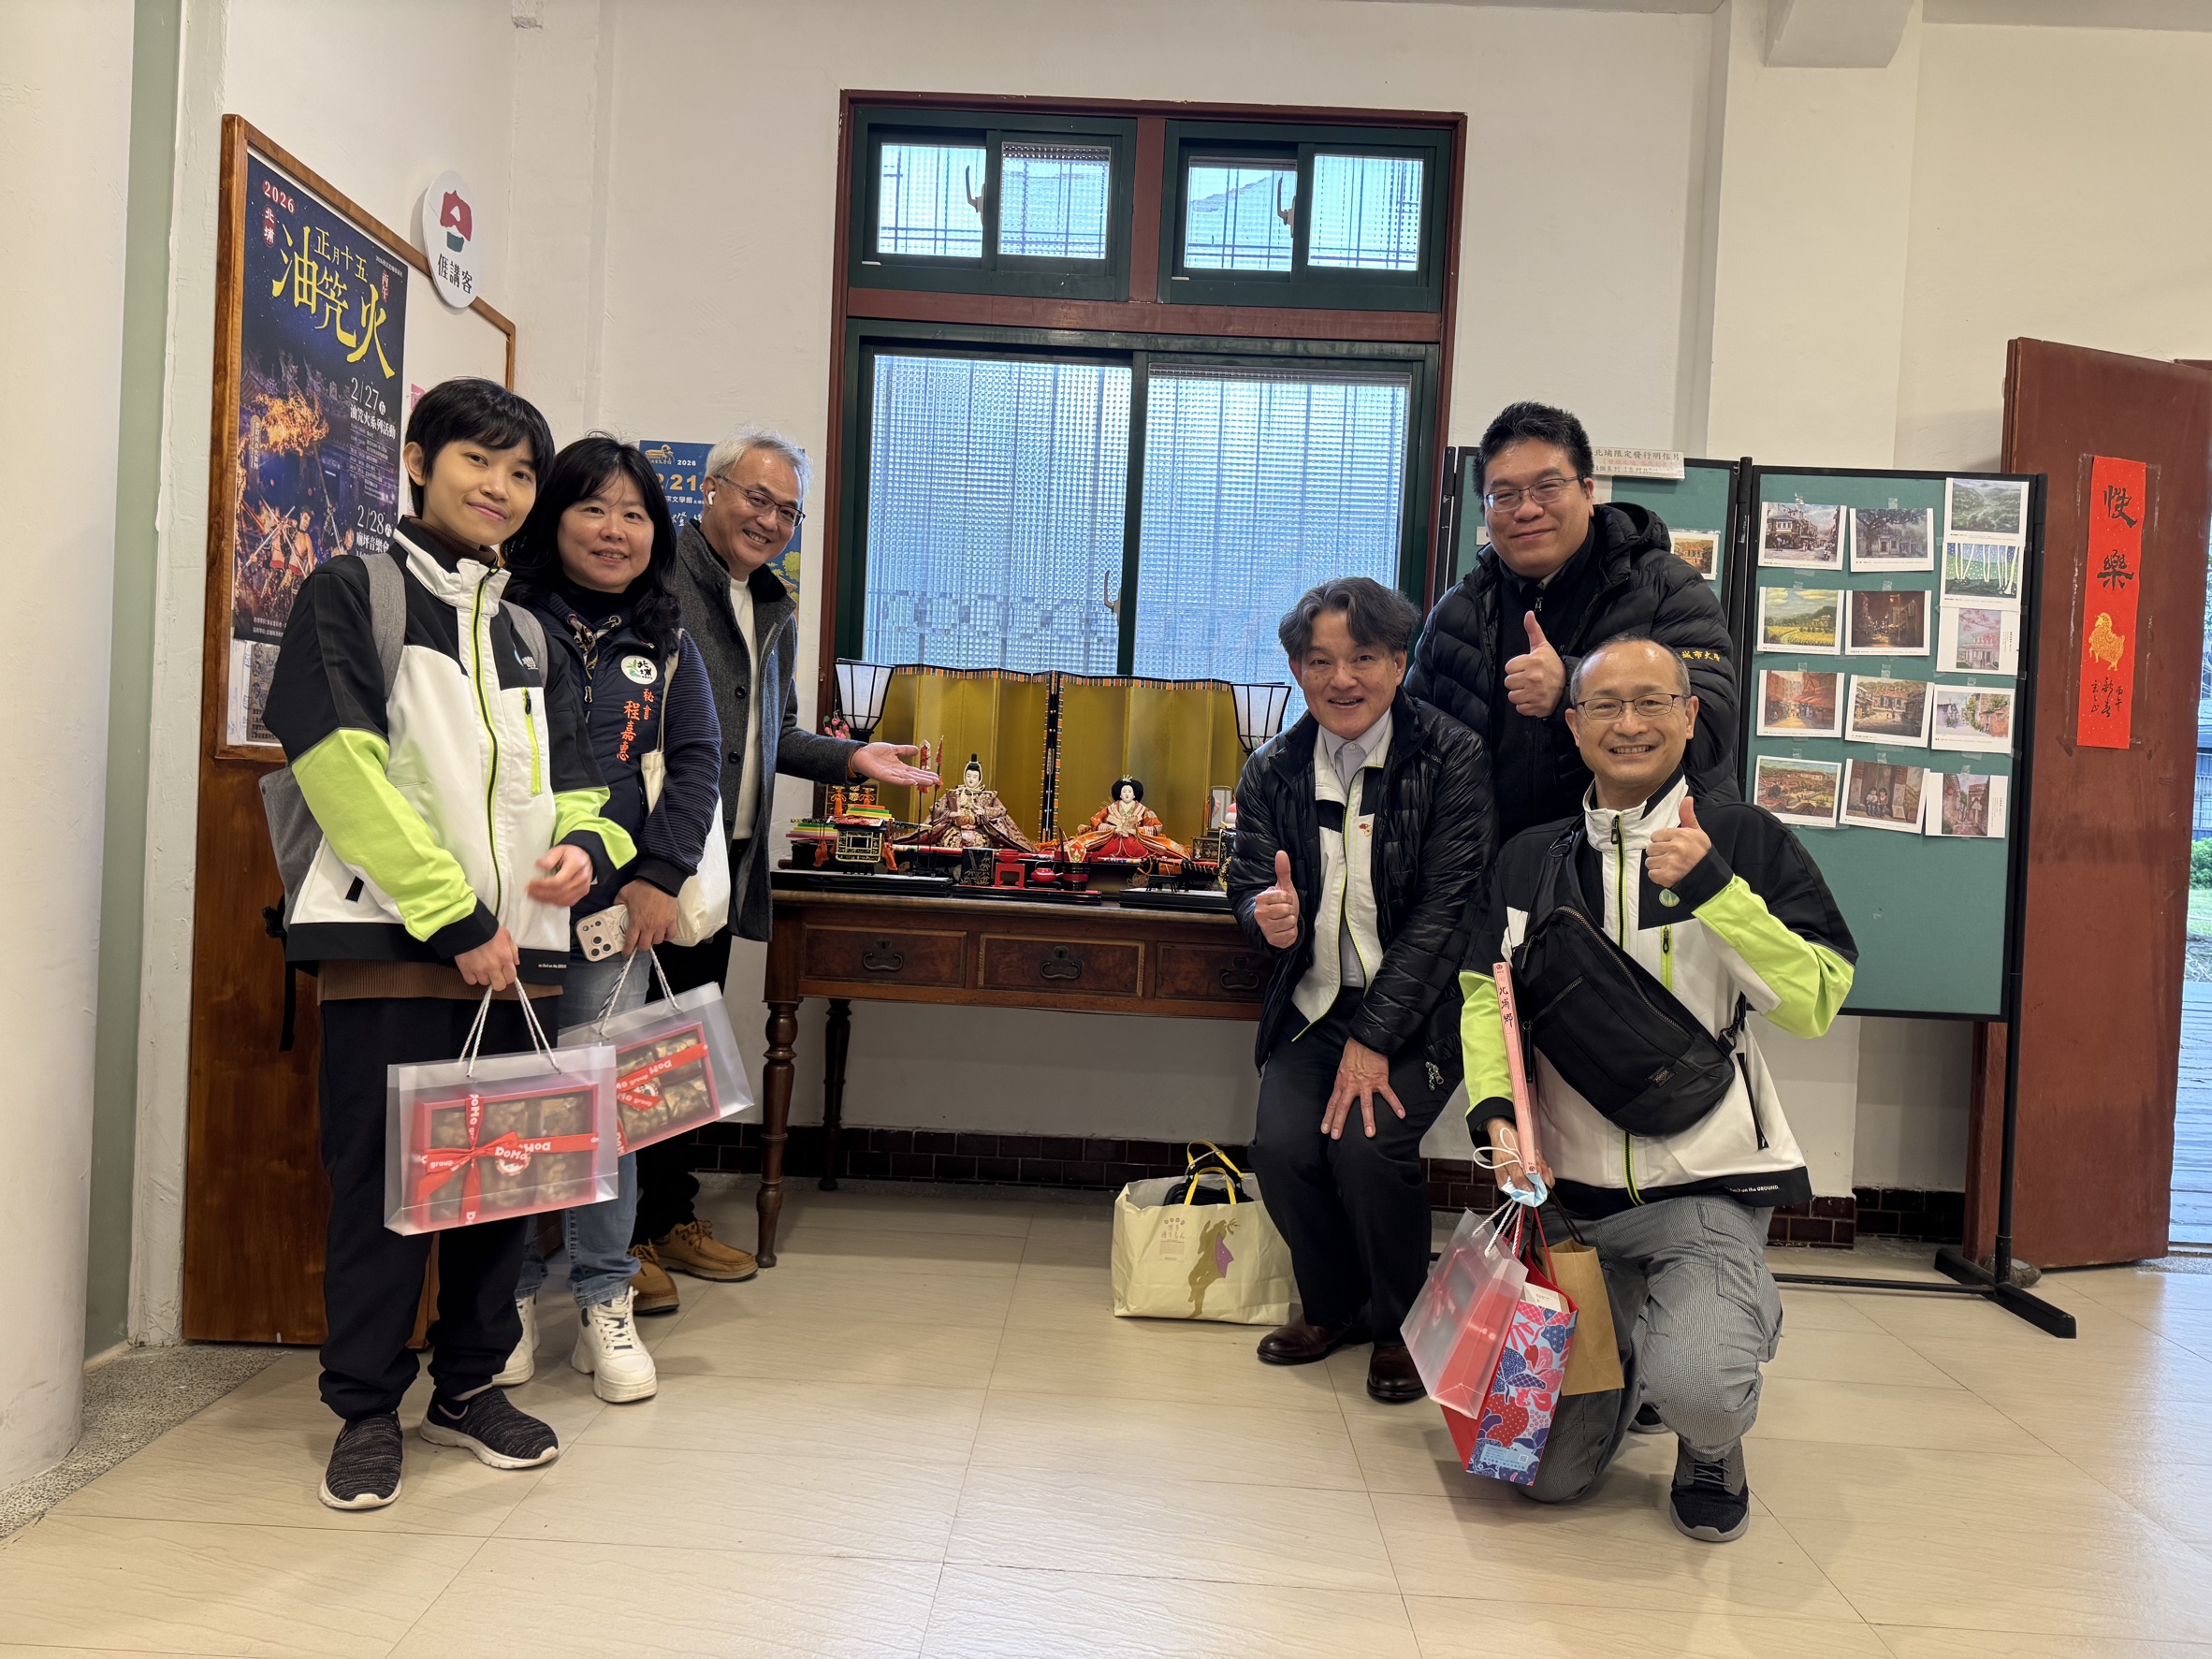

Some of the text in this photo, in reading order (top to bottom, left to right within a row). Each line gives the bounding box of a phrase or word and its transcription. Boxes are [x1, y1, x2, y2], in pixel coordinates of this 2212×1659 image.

[264, 181, 294, 213] 2026
[264, 207, 275, 244] 北埔
[313, 226, 368, 283] 正月十五
[351, 377, 379, 411] 2/27
[1594, 449, 1680, 460] 北埔限定發行明信片
[357, 504, 384, 535] 2/28
[643, 688, 654, 720] 秘書
[429, 1158, 454, 1169] group
